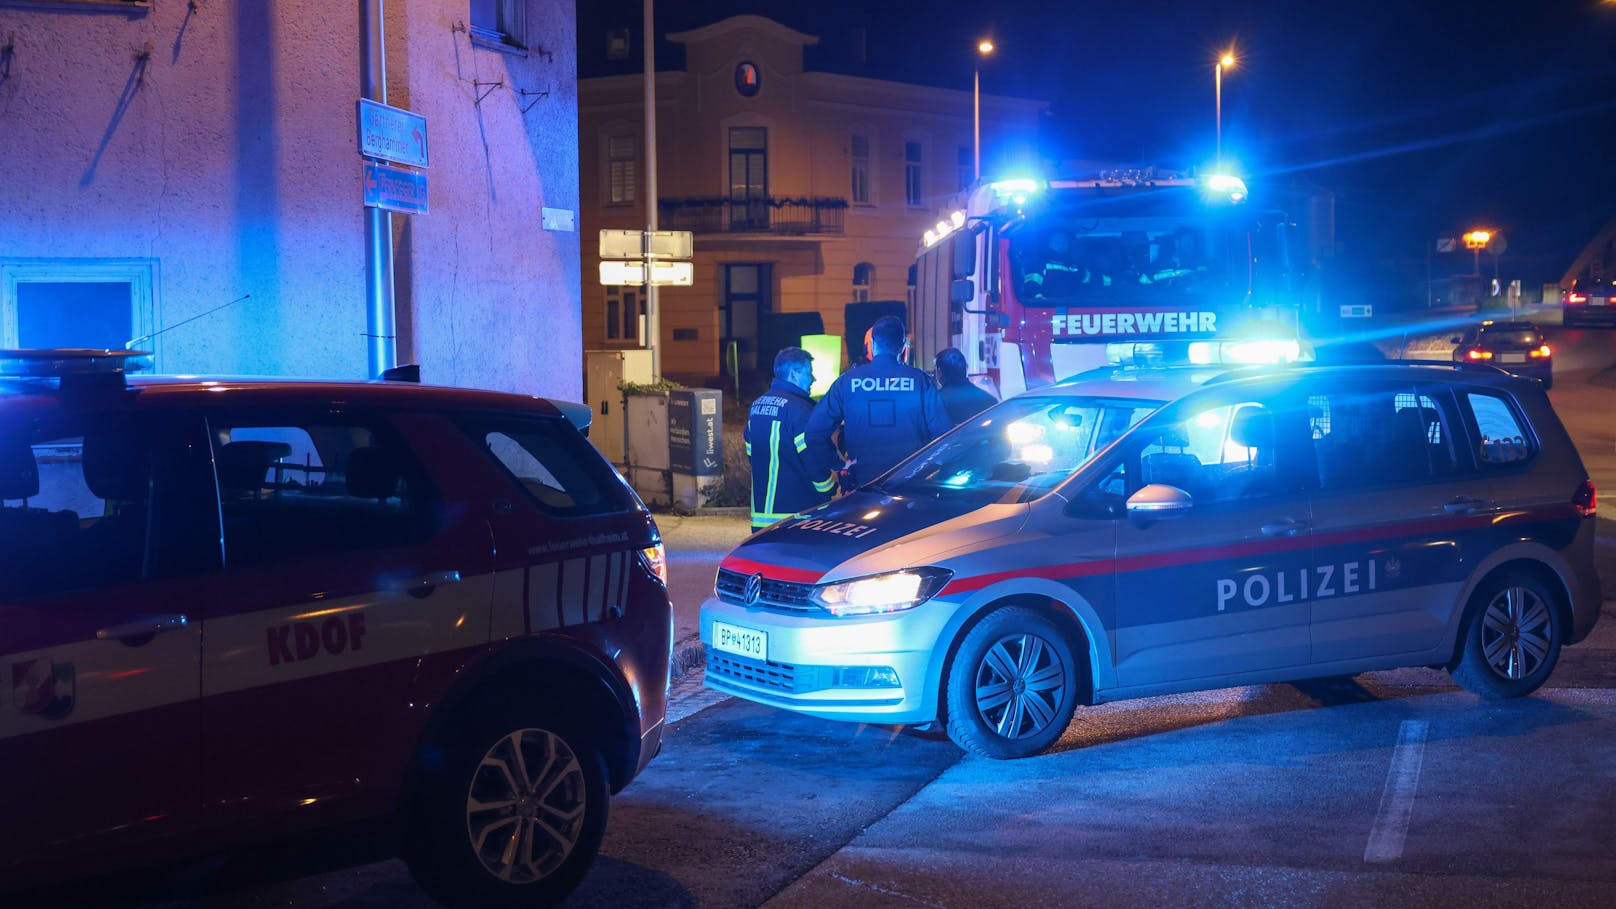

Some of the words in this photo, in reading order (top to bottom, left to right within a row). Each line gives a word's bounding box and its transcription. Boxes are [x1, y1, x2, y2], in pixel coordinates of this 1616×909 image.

[1051, 312, 1217, 336] FEUERWEHR
[851, 377, 915, 393] POLIZEI
[787, 519, 878, 539] POLIZEI
[1216, 559, 1377, 612] POLIZEI
[265, 613, 367, 667] KDOF
